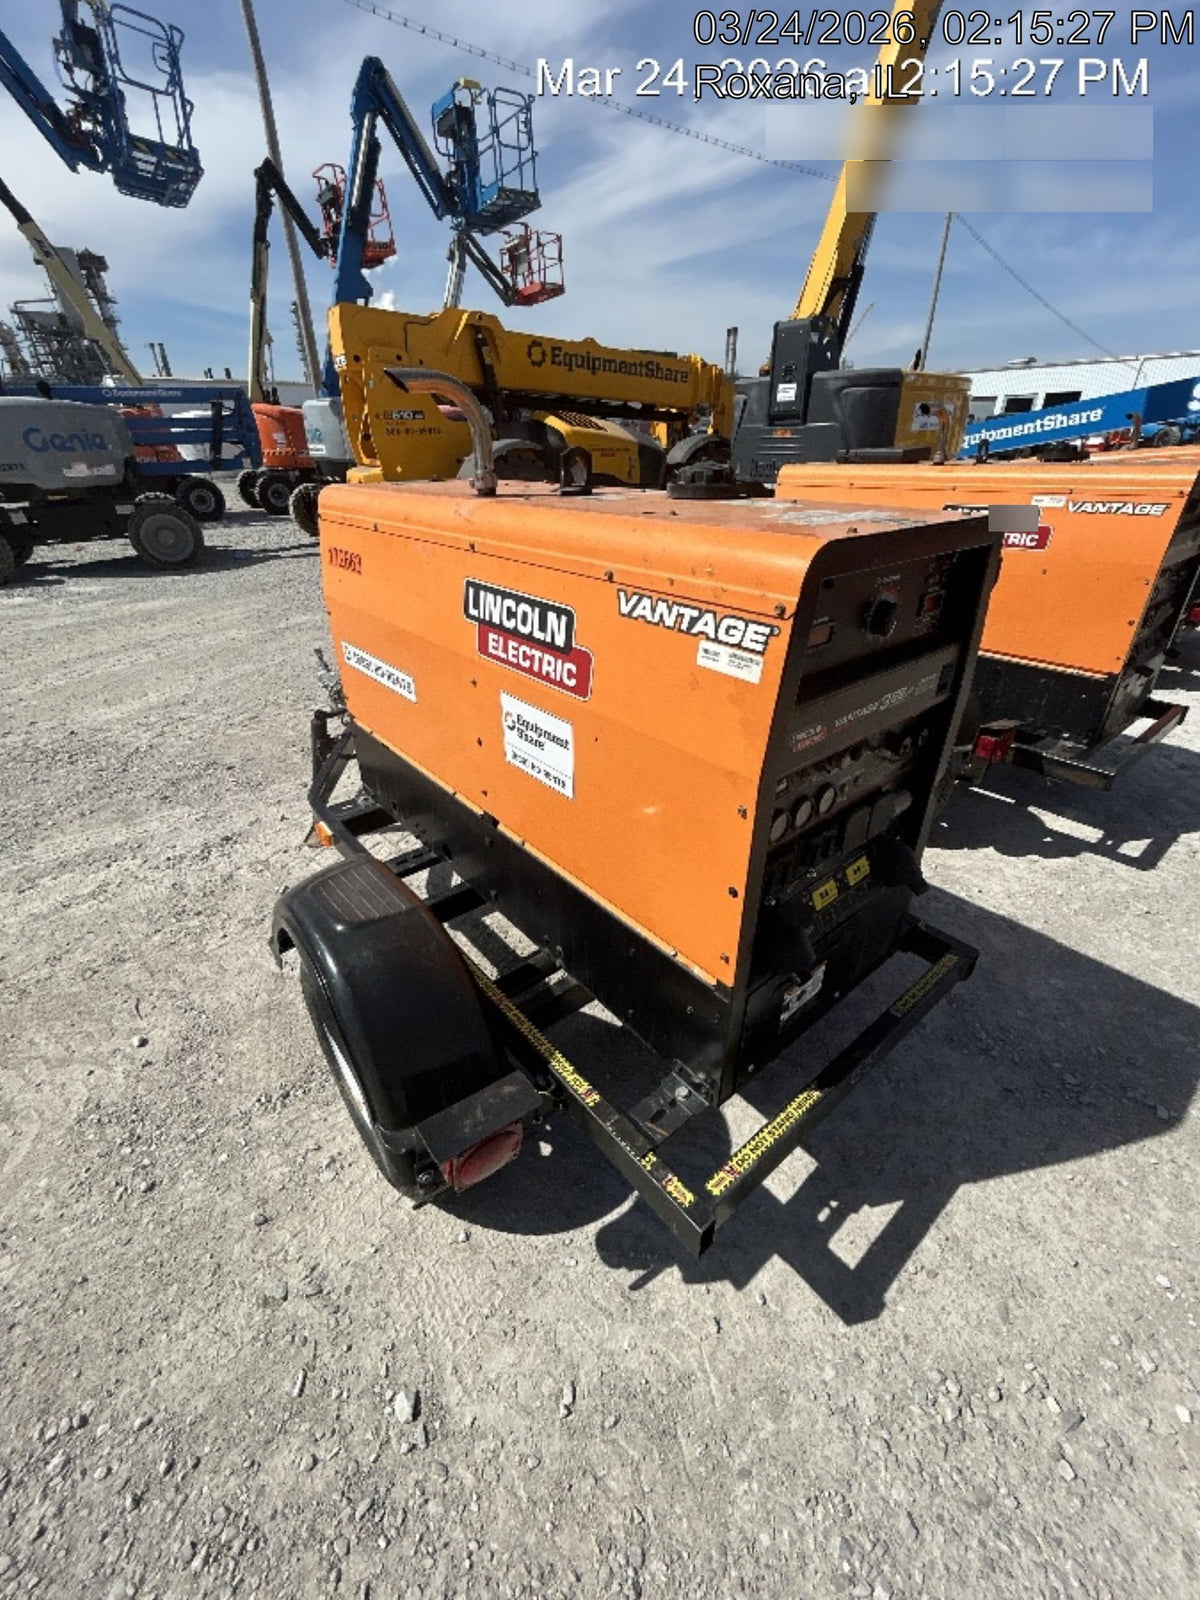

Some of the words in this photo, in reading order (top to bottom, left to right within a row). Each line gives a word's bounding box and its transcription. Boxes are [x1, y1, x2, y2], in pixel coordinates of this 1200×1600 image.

[550, 345, 690, 384] EquipmentShare
[961, 408, 1104, 449] quipmentShare
[1067, 501, 1168, 517] VANTAGE
[467, 585, 568, 648] LINCOLN
[617, 589, 772, 652] VANTAGE
[487, 631, 578, 688] ELECTRIC
